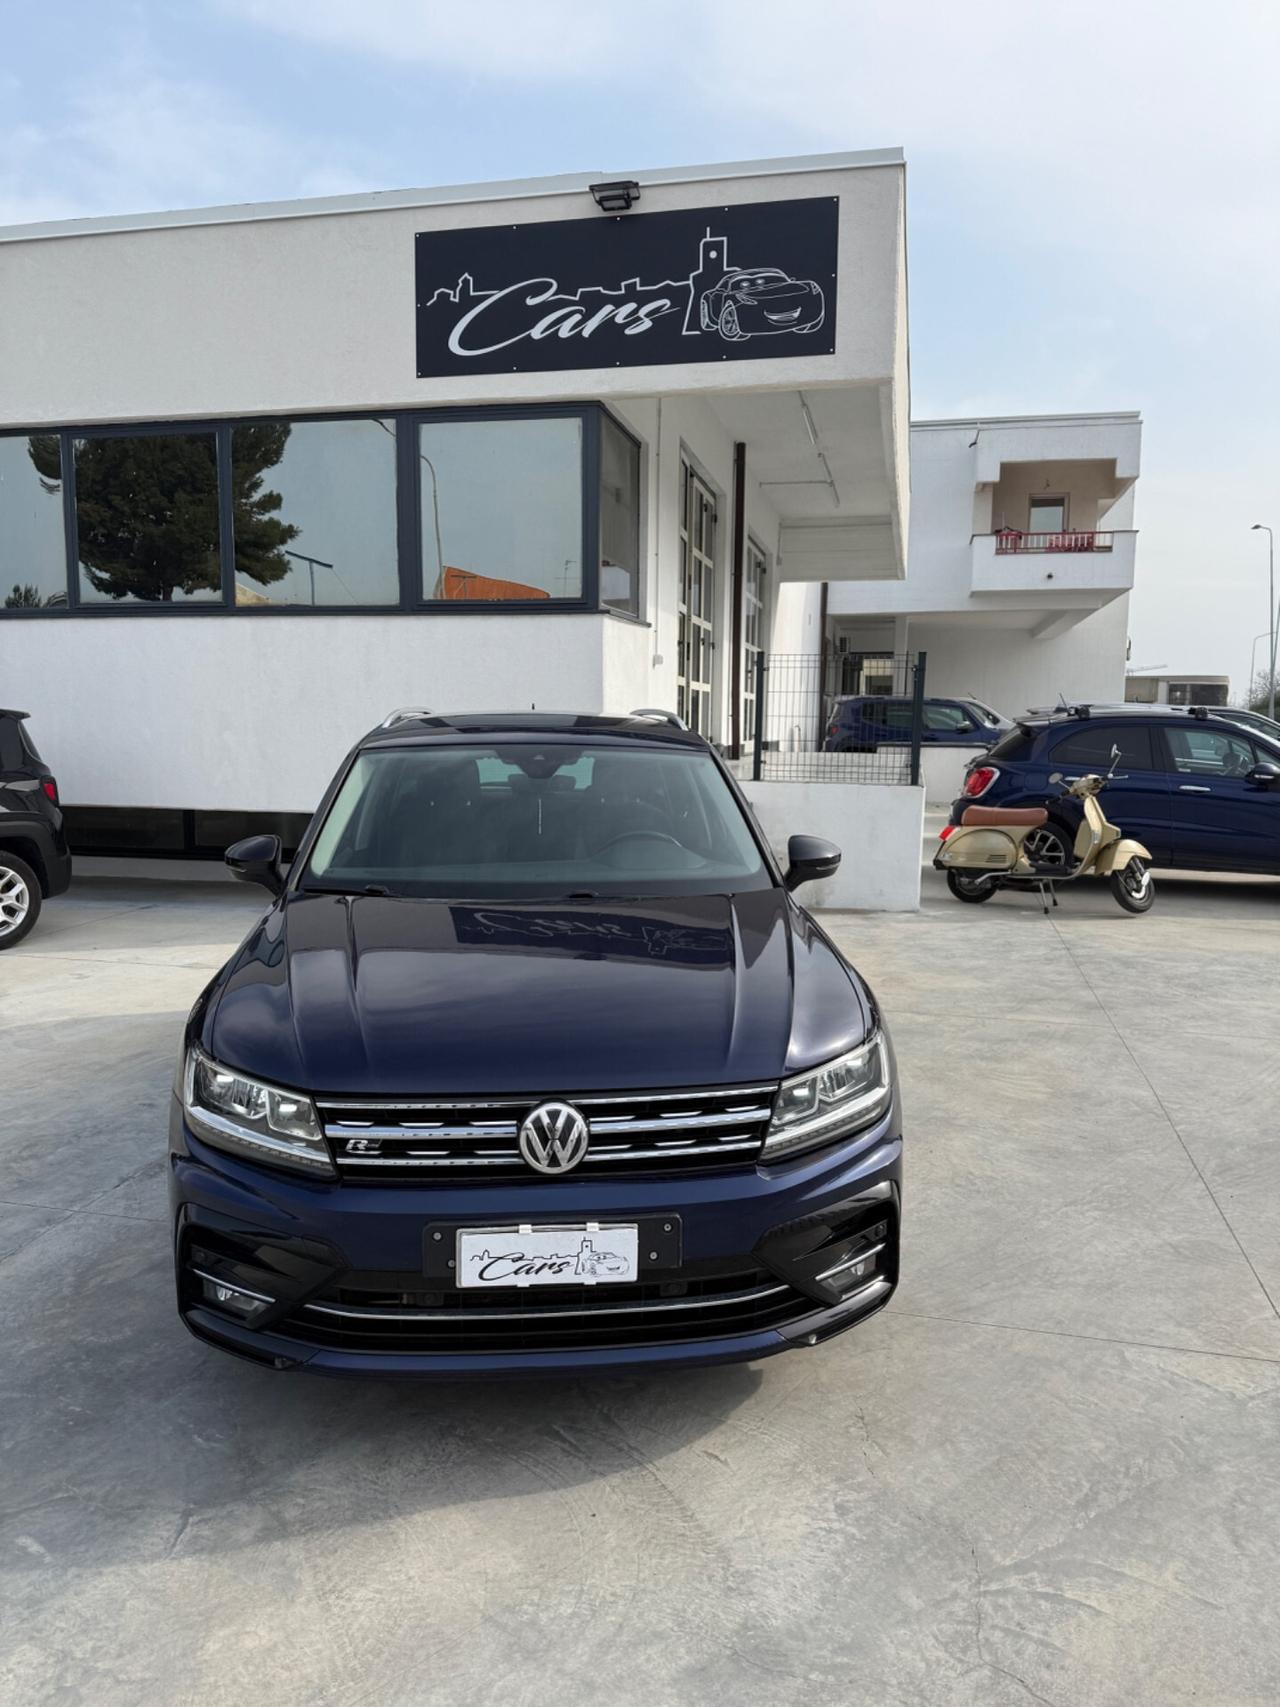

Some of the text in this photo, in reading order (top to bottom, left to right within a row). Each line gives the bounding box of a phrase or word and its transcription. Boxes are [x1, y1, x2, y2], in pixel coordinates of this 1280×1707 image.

[448, 277, 680, 357] Cars
[522, 1104, 587, 1172] VW
[478, 1252, 573, 1282] Cars
